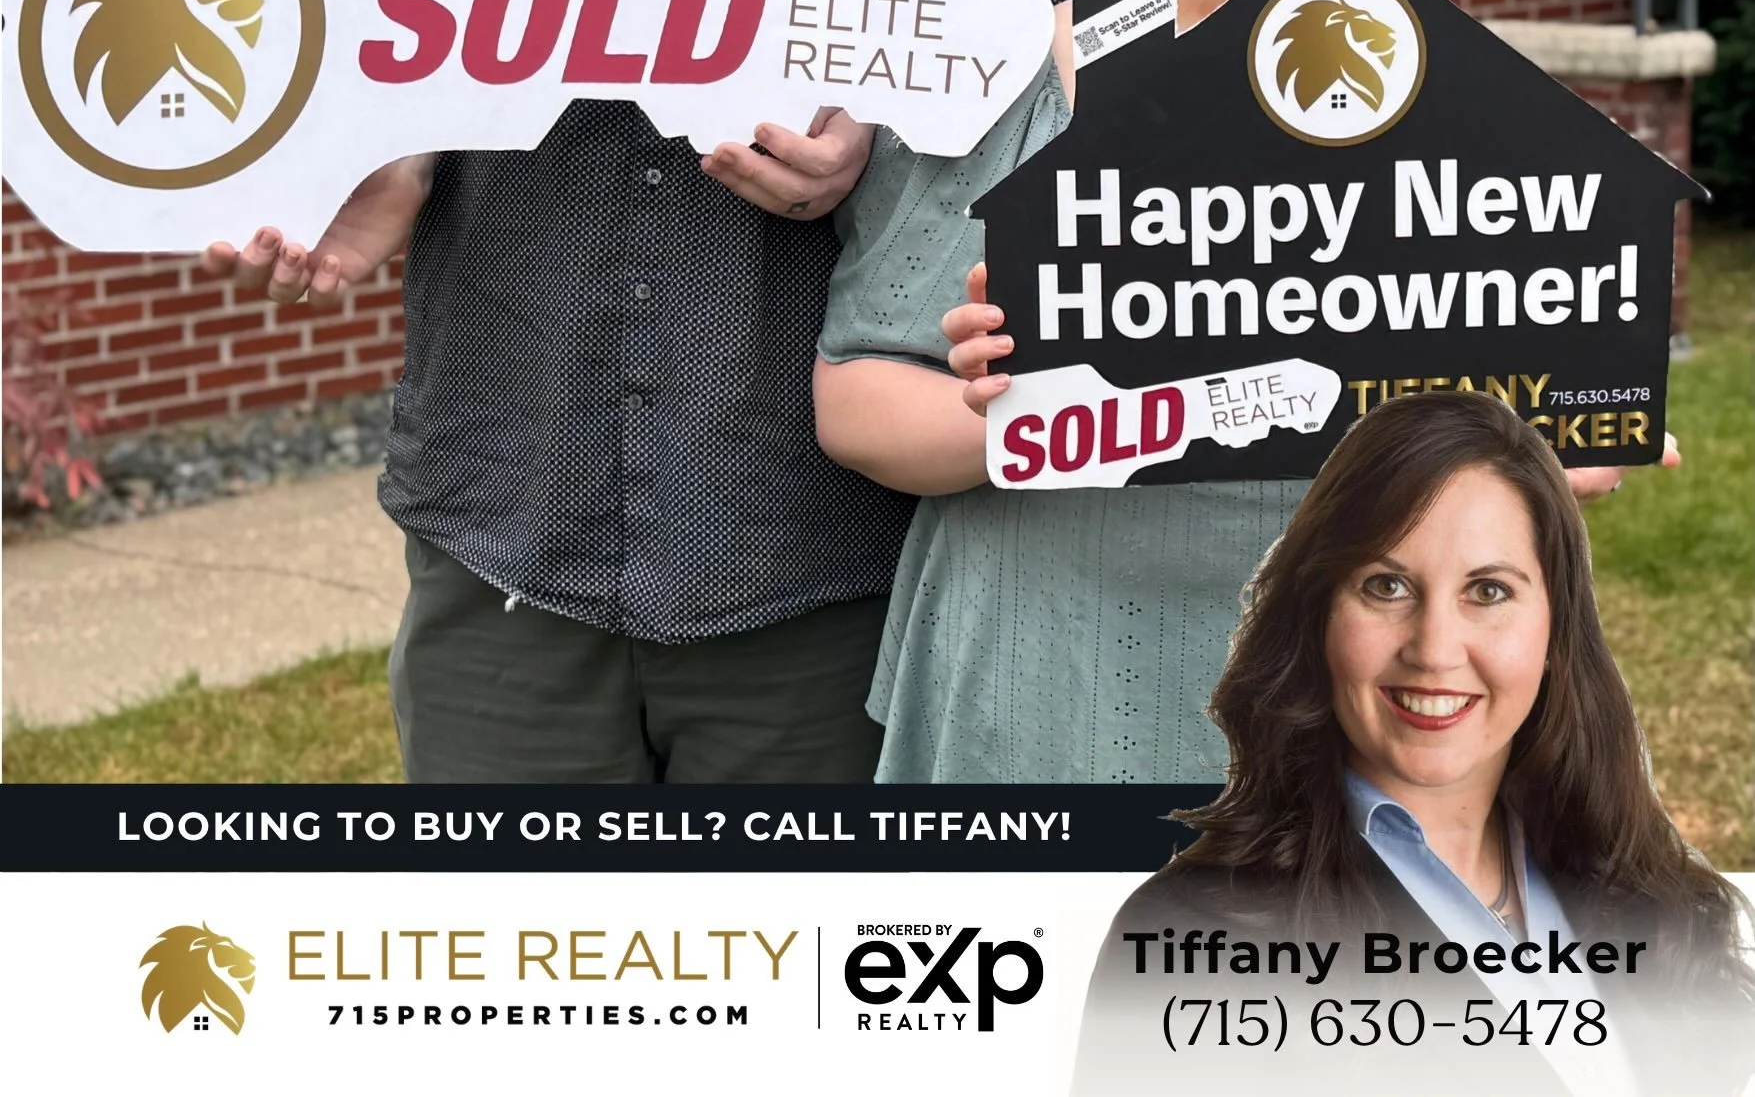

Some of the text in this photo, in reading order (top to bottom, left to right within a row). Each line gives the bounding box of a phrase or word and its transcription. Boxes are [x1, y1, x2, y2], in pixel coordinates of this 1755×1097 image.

[1098, 20, 1120, 35] Scan
[1119, 15, 1130, 24] to
[1129, 1, 1155, 18] Leave
[1113, 0, 1173, 37] 5-Star Review!
[783, 41, 1008, 98] REALTY
[1057, 159, 1602, 264] Happy New
[1038, 244, 1639, 340] Homeowner!
[1207, 374, 1285, 407] ELITE
[1549, 387, 1651, 406] 715.630.5478
[1212, 391, 1317, 431] REALTY
[1002, 386, 1185, 482] SOLD
